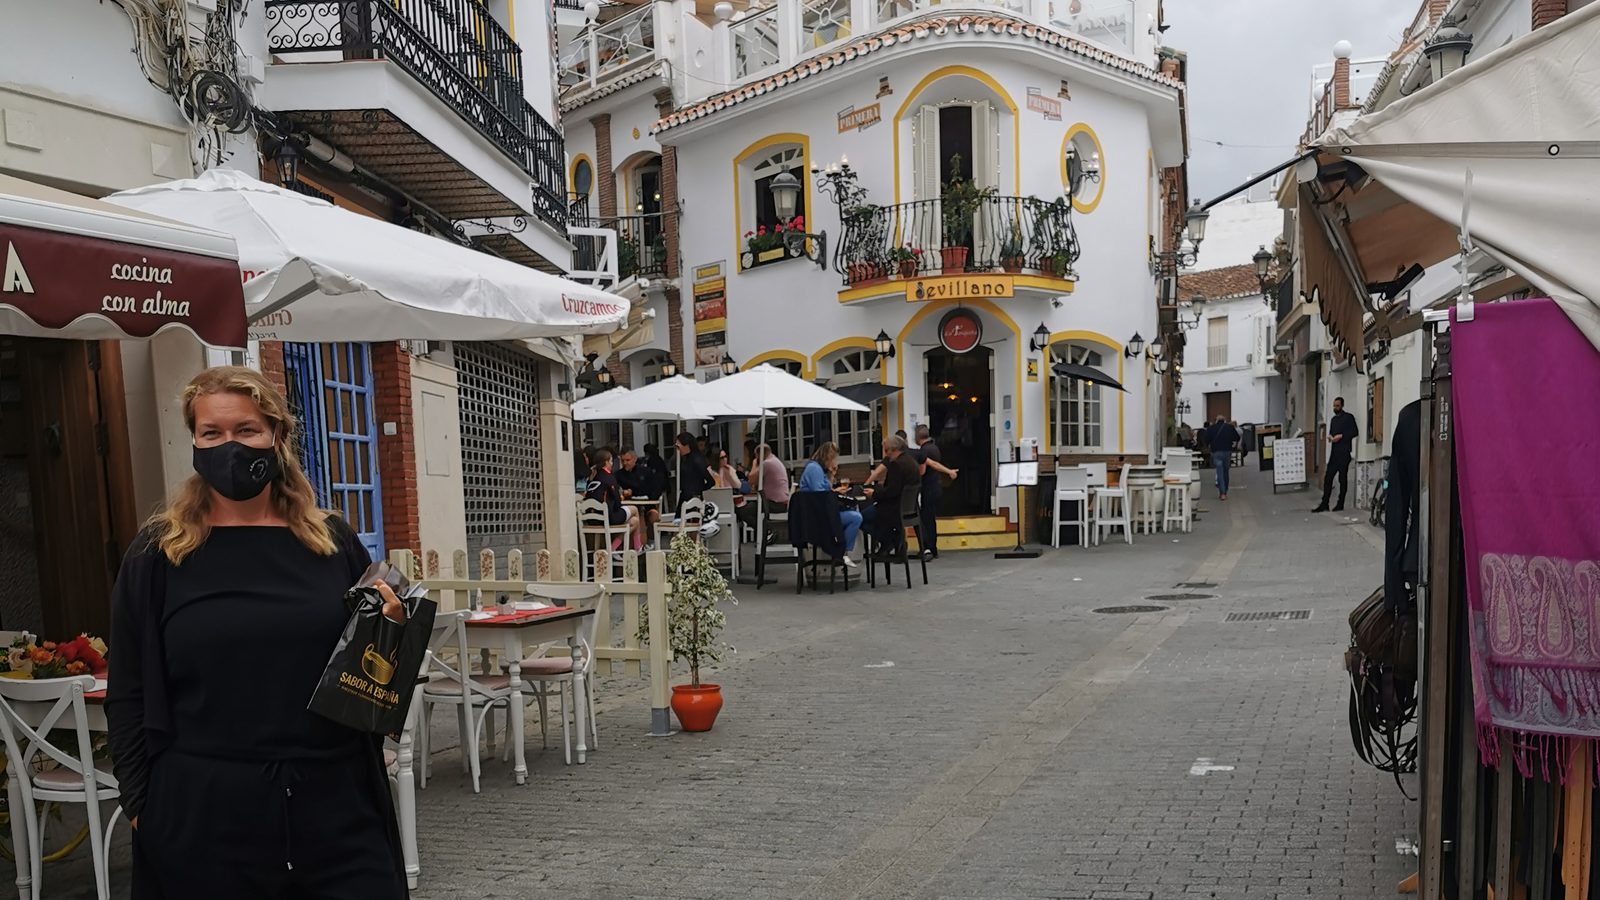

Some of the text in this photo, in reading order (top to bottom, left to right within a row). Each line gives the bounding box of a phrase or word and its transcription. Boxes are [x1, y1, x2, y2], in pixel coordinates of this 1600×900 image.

[839, 106, 880, 130] PRIMERA
[110, 257, 173, 284] cocina
[916, 281, 1005, 299] Sevillano
[101, 290, 191, 317] con alma
[561, 293, 625, 316] Cruzcampo
[340, 672, 366, 691] SABOR
[366, 684, 374, 694] A
[373, 687, 399, 704] ESPAÑA
